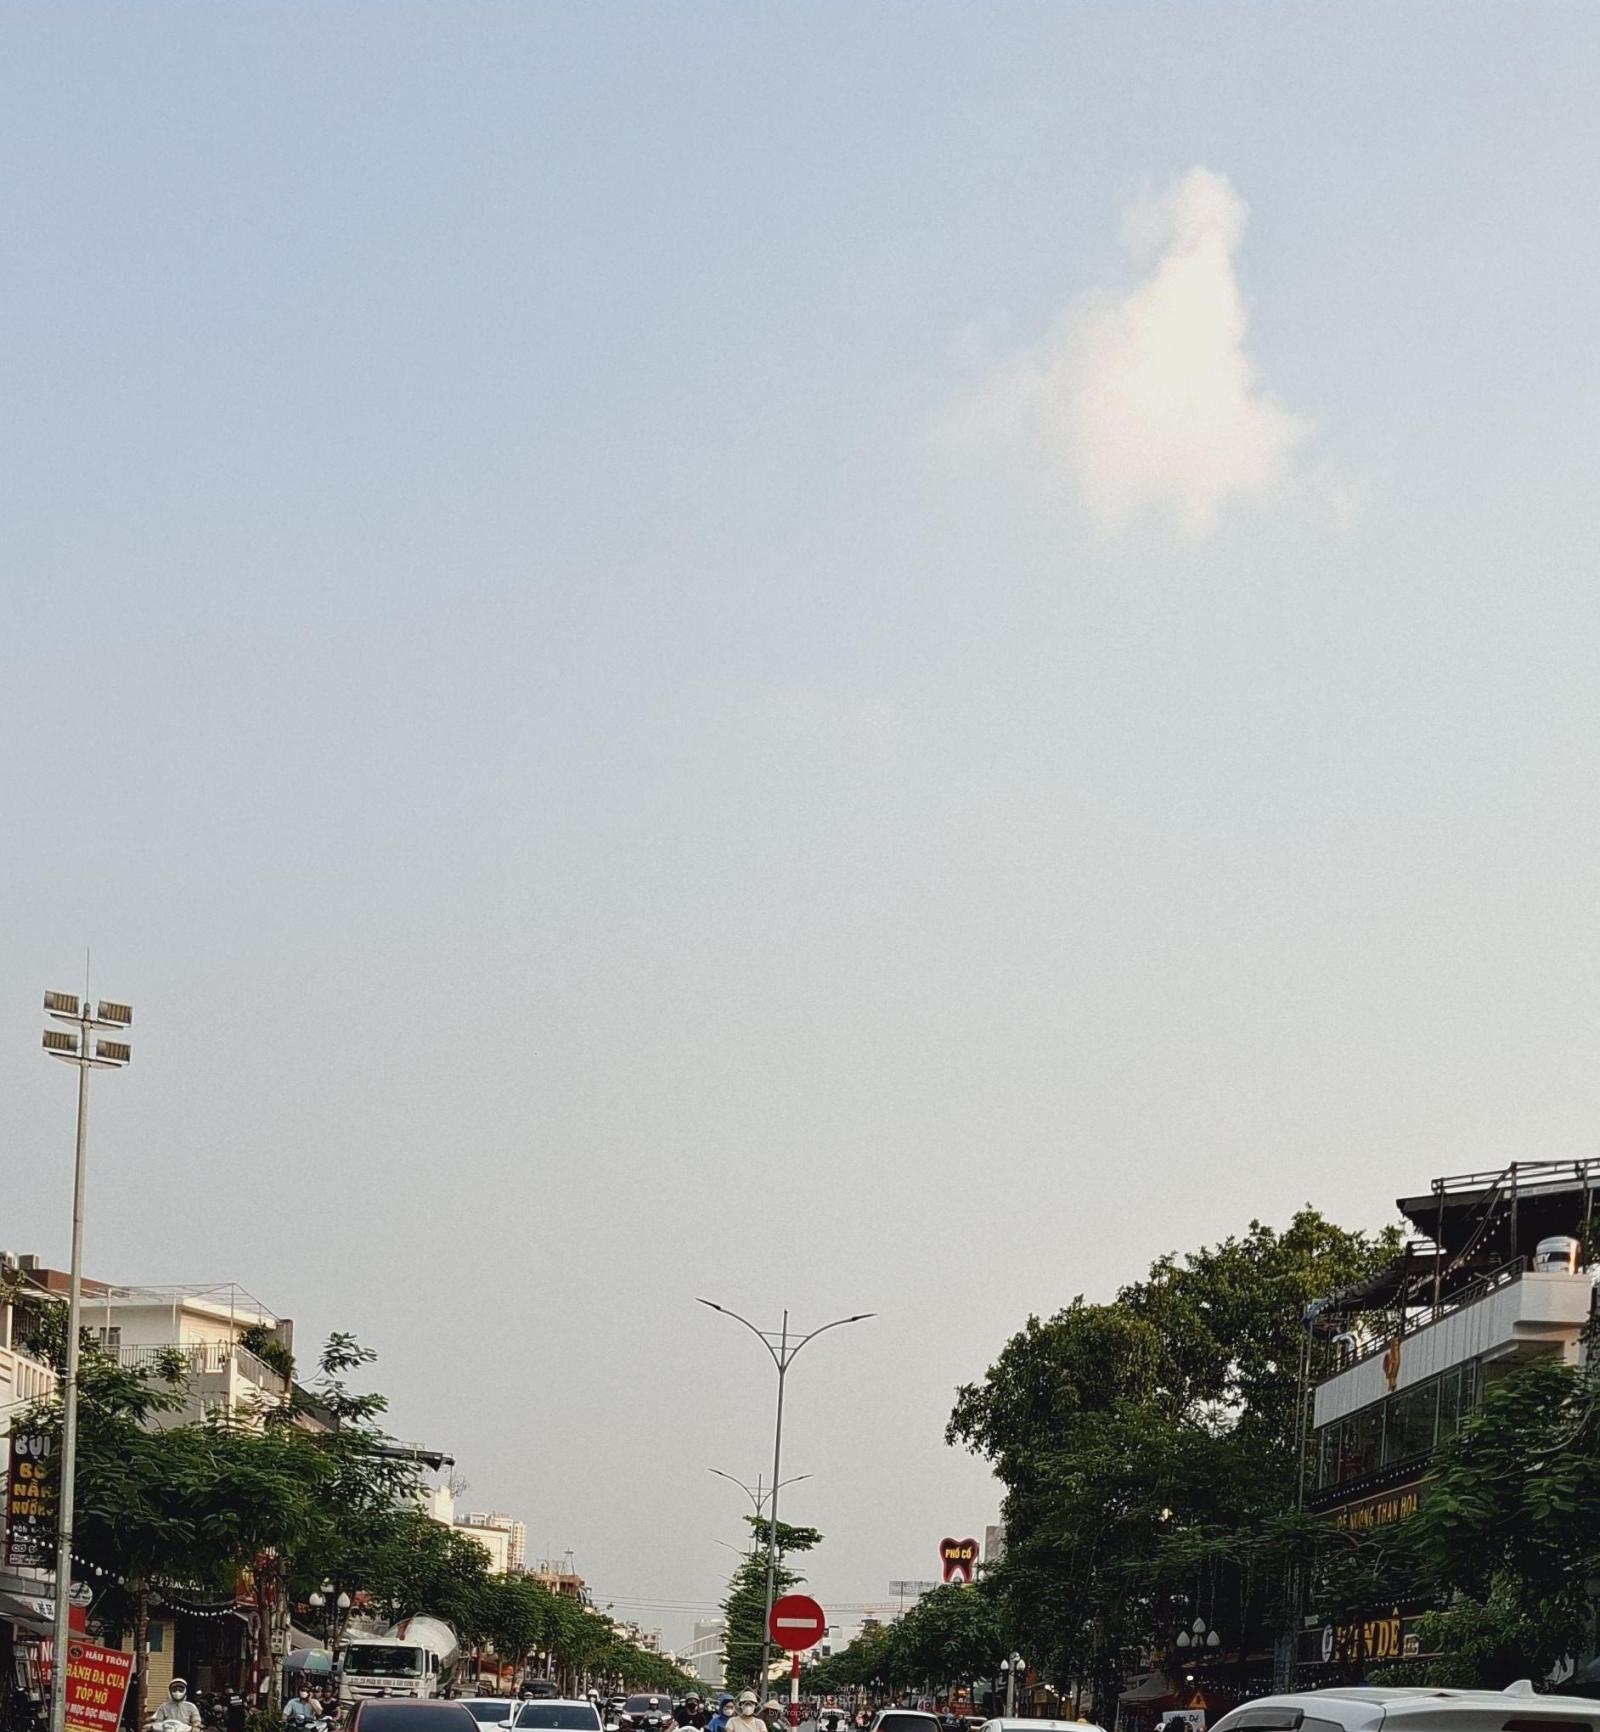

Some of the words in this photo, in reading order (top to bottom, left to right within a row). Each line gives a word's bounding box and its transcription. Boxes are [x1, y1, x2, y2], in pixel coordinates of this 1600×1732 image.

[64, 1662, 92, 1681] BÁNH
[92, 1669, 105, 1685] ĐA
[107, 1673, 125, 1689] CUA
